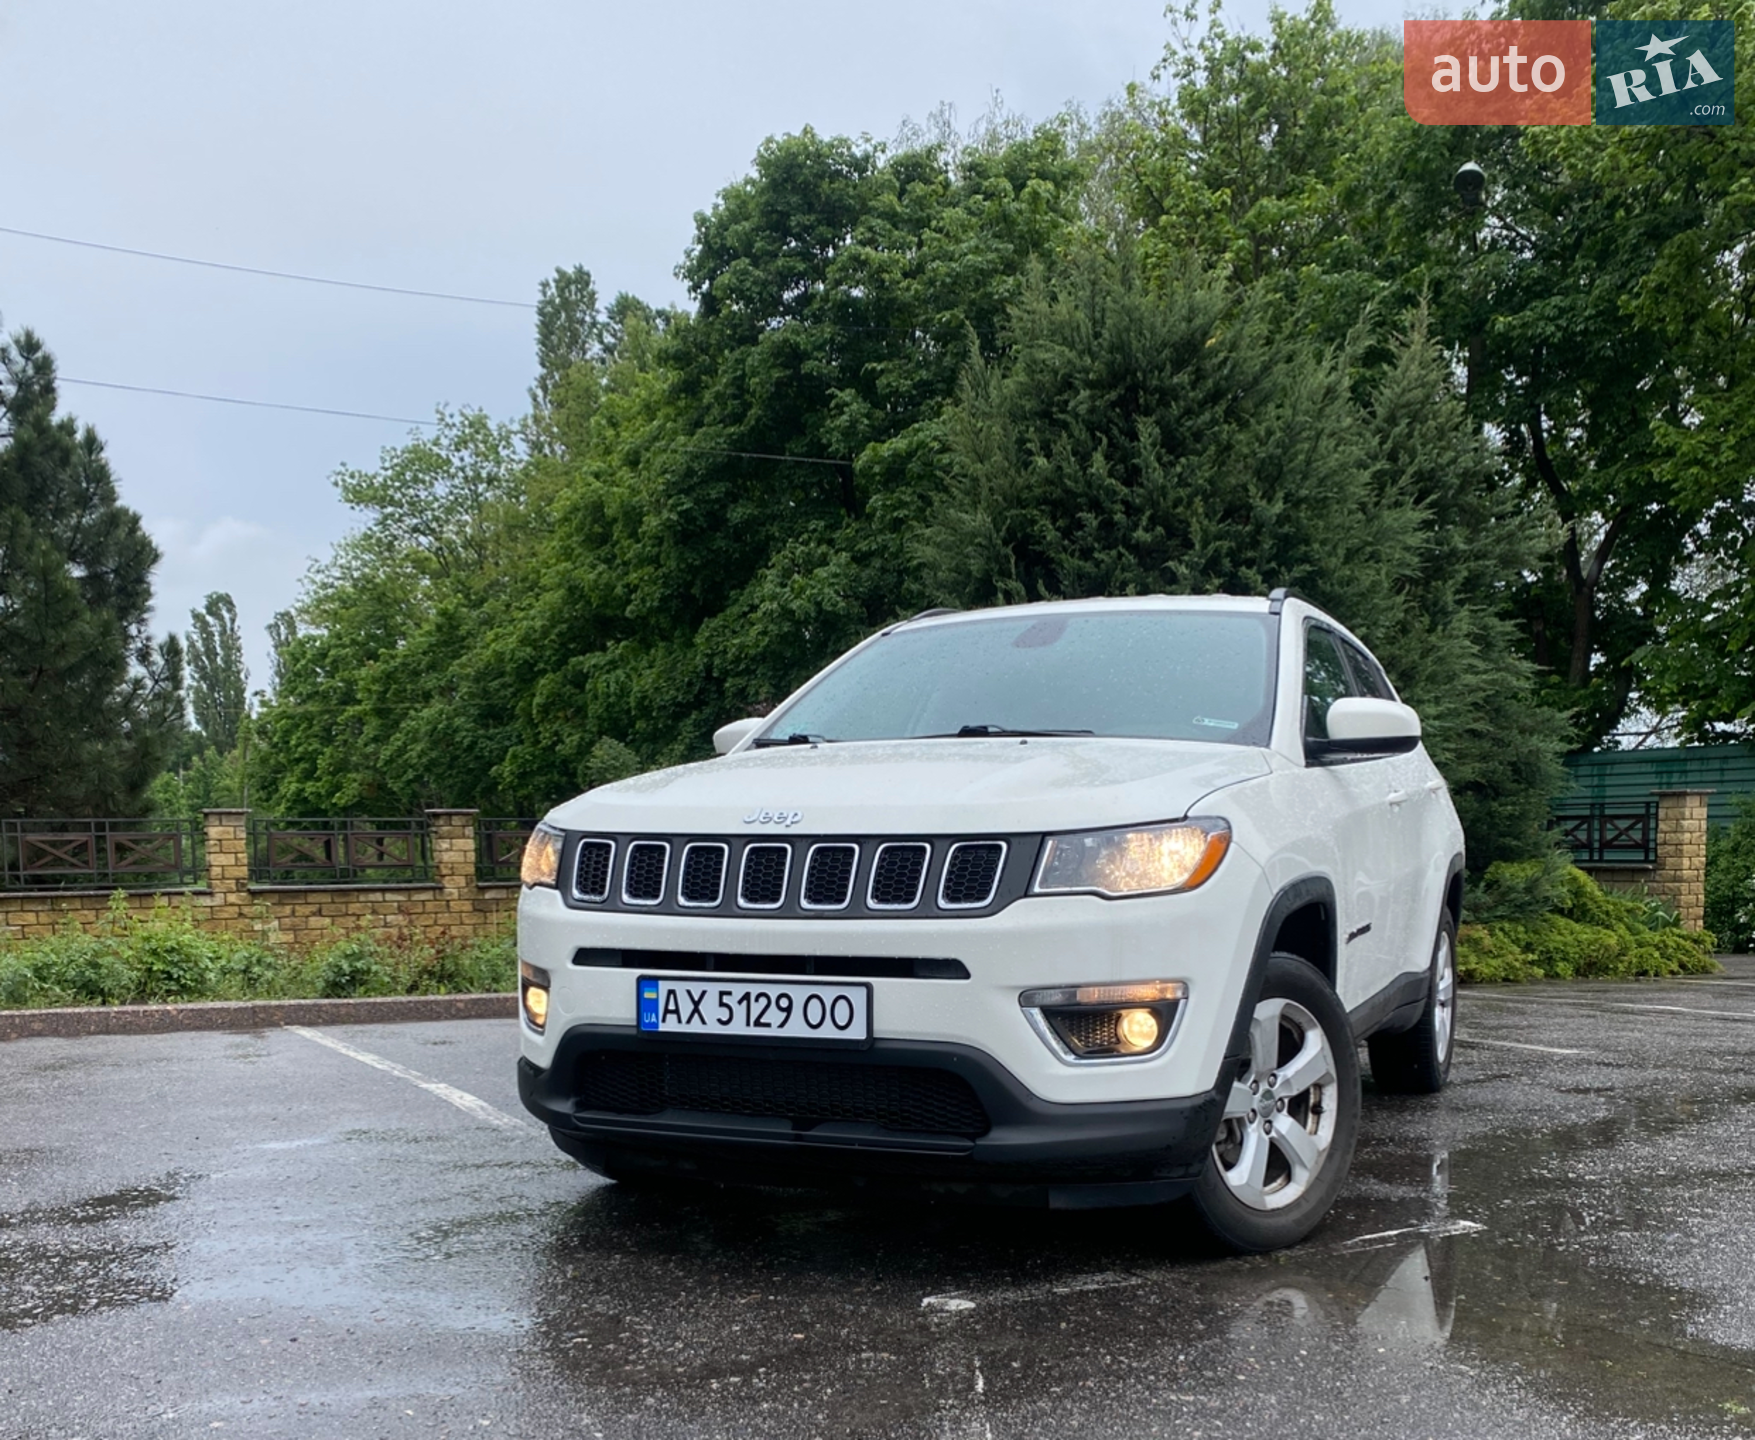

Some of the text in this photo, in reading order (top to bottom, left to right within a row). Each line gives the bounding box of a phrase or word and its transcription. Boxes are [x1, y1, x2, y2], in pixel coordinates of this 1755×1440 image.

[743, 807, 804, 828] Jeep
[643, 1012, 658, 1024] UA
[661, 989, 854, 1031] AX 5129 OO
